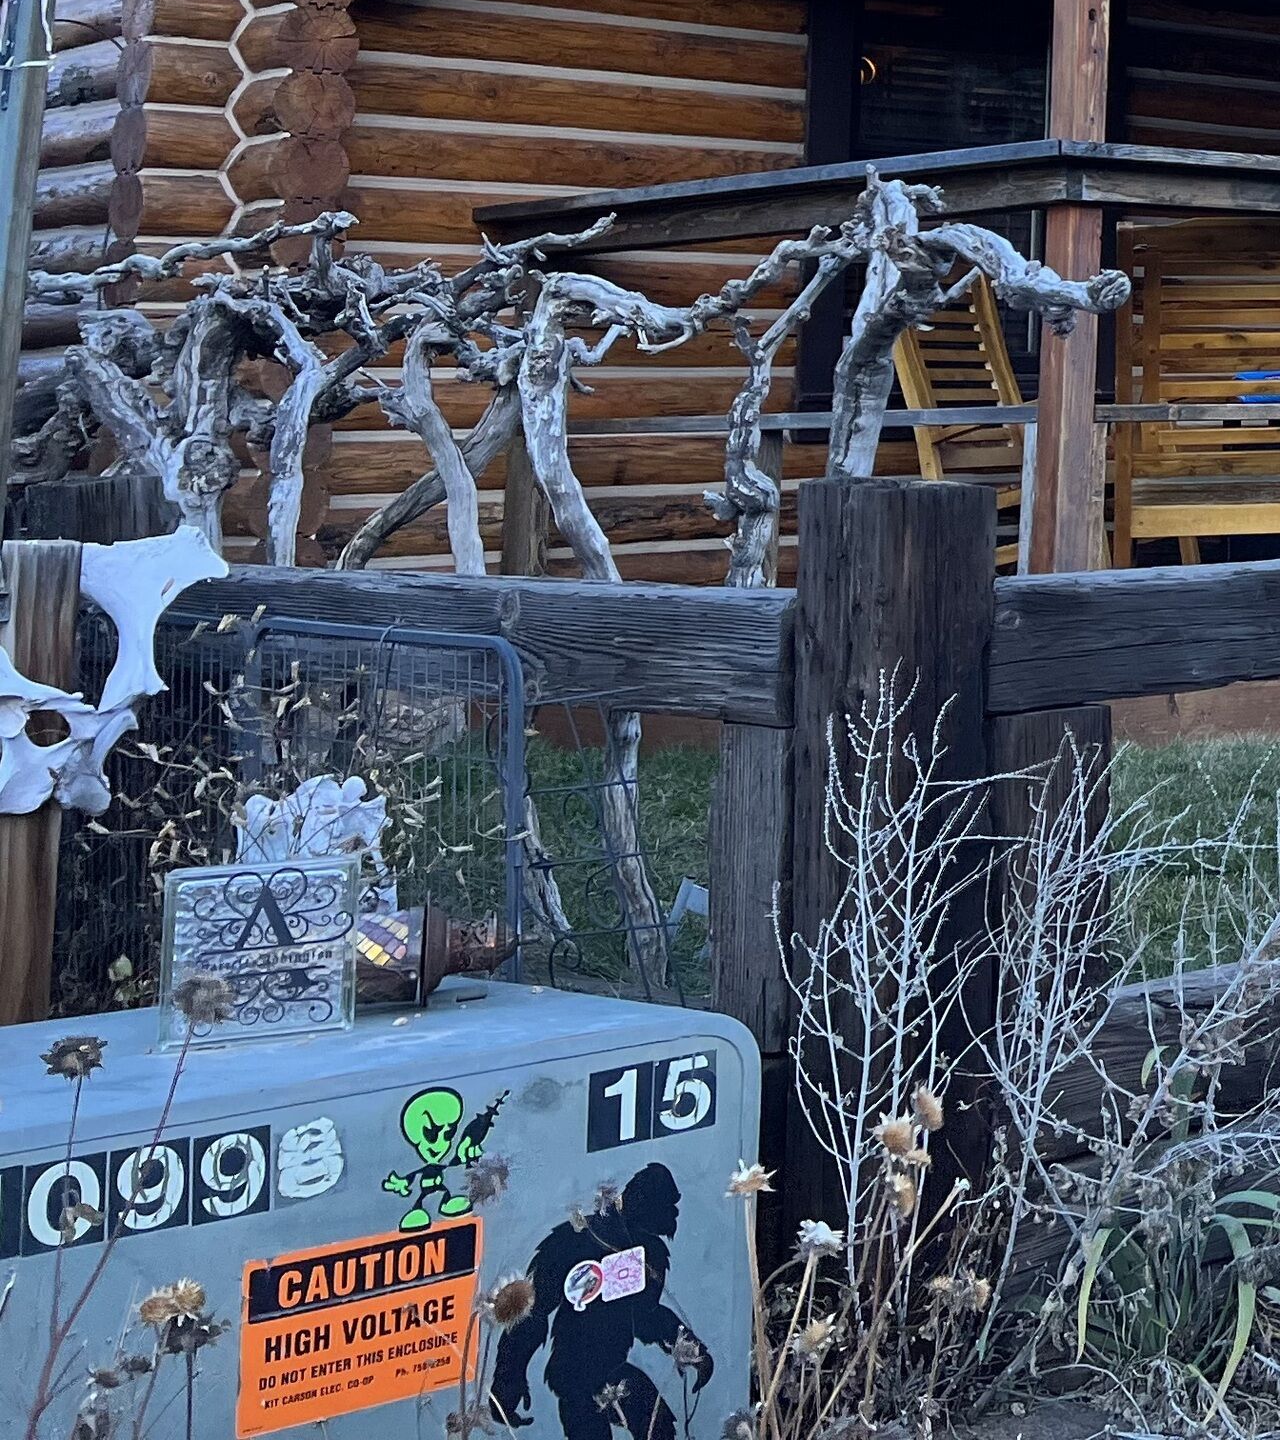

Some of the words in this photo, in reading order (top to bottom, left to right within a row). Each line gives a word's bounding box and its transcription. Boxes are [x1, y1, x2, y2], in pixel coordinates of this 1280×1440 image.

[604, 1055, 711, 1140] 15
[278, 1238, 446, 1309] CAUTION
[259, 1375, 276, 1390] DO
[281, 1368, 306, 1386] NOT
[311, 1358, 351, 1378] ENTER
[357, 1349, 384, 1367] THIS
[388, 1331, 458, 1361] ENCLOSURE
[264, 1325, 331, 1363] HIGH
[343, 1295, 455, 1345] VOLTAGE
[264, 1398, 279, 1409] KIT
[282, 1390, 317, 1406] CARSON
[347, 1376, 374, 1389] CO-OP
[413, 1356, 450, 1373] 7582258
